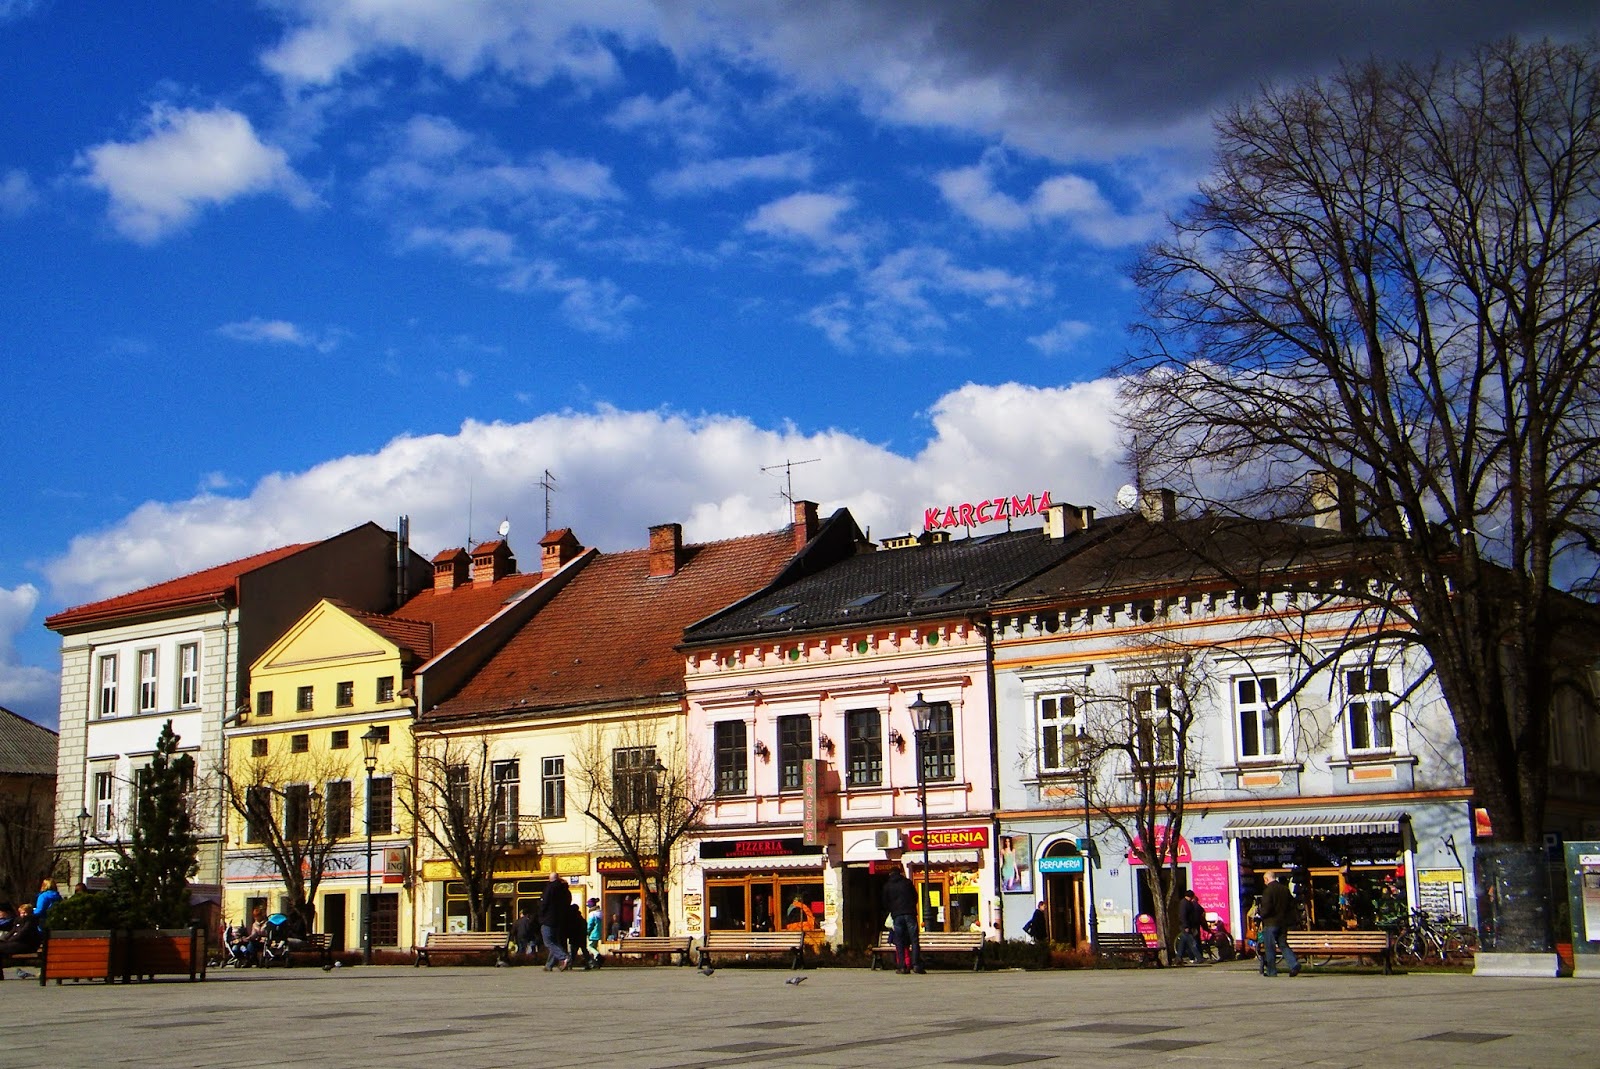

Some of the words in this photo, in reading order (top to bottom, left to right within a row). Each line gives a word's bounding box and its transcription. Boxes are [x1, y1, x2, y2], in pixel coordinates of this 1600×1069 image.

[924, 490, 1051, 531] KARCZMA
[911, 831, 984, 845] CUKIERNIA
[735, 841, 783, 852] PIZZERIA
[387, 862, 402, 871] ING
[1040, 860, 1080, 869] PERFUMERIA
